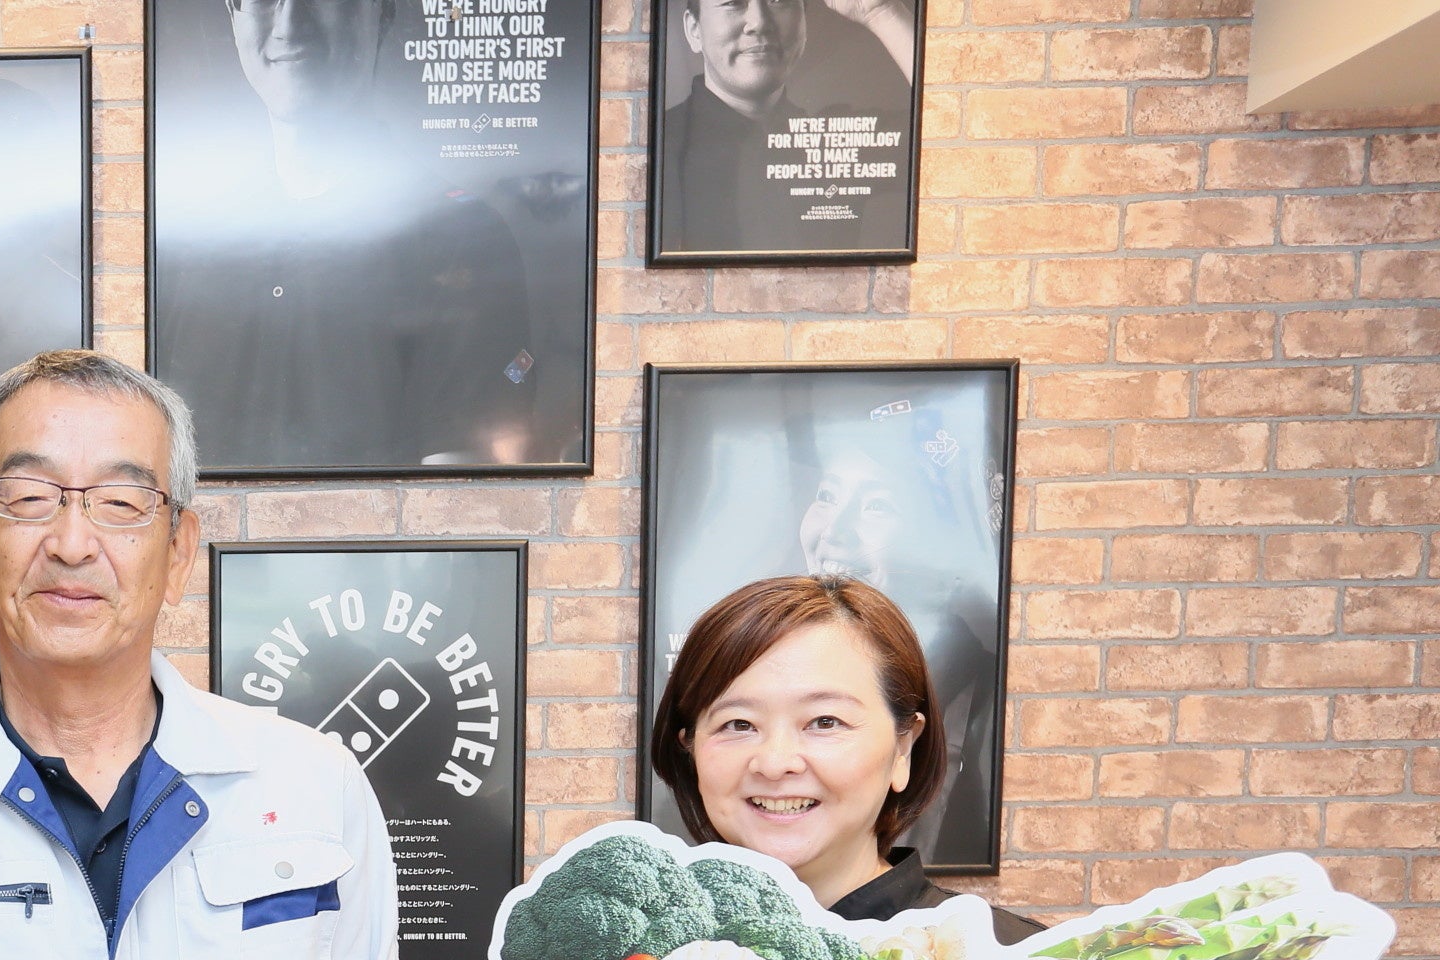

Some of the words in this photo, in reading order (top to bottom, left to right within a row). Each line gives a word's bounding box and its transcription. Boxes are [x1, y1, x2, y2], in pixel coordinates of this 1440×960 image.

[479, 0, 548, 14] HUNGRY
[425, 17, 447, 38] TO
[451, 16, 505, 37] THINK
[509, 15, 545, 35] OUR
[404, 39, 511, 60] CUSTOMER'S
[516, 37, 565, 58] FIRST
[422, 62, 457, 82] AND
[462, 61, 493, 82] SEE
[499, 60, 547, 81] MORE
[428, 84, 485, 104] HAPPY
[488, 83, 541, 103] FACES
[422, 119, 457, 129] HUNGRY
[460, 119, 470, 129] TO
[492, 118, 503, 128] BE
[506, 117, 538, 128] BETTER
[788, 118, 826, 133] WE'RE
[828, 117, 878, 132] HUNGRY
[768, 134, 791, 148] FOR
[794, 133, 822, 148] NEW
[823, 132, 901, 147] TECHNOLOGY
[805, 149, 821, 163] TO
[824, 148, 858, 163] MAKE
[766, 164, 823, 179] PEOPLE'S
[825, 163, 851, 179] LIFE
[854, 162, 897, 178] EASIER
[790, 188, 815, 196] HUNGRY
[816, 187, 824, 195] TO
[838, 187, 847, 195] BE
[848, 187, 871, 195] BETTER
[242, 616, 310, 708] GRY
[308, 588, 366, 638] TO
[382, 589, 443, 646] BE
[435, 632, 499, 797] BETTER
